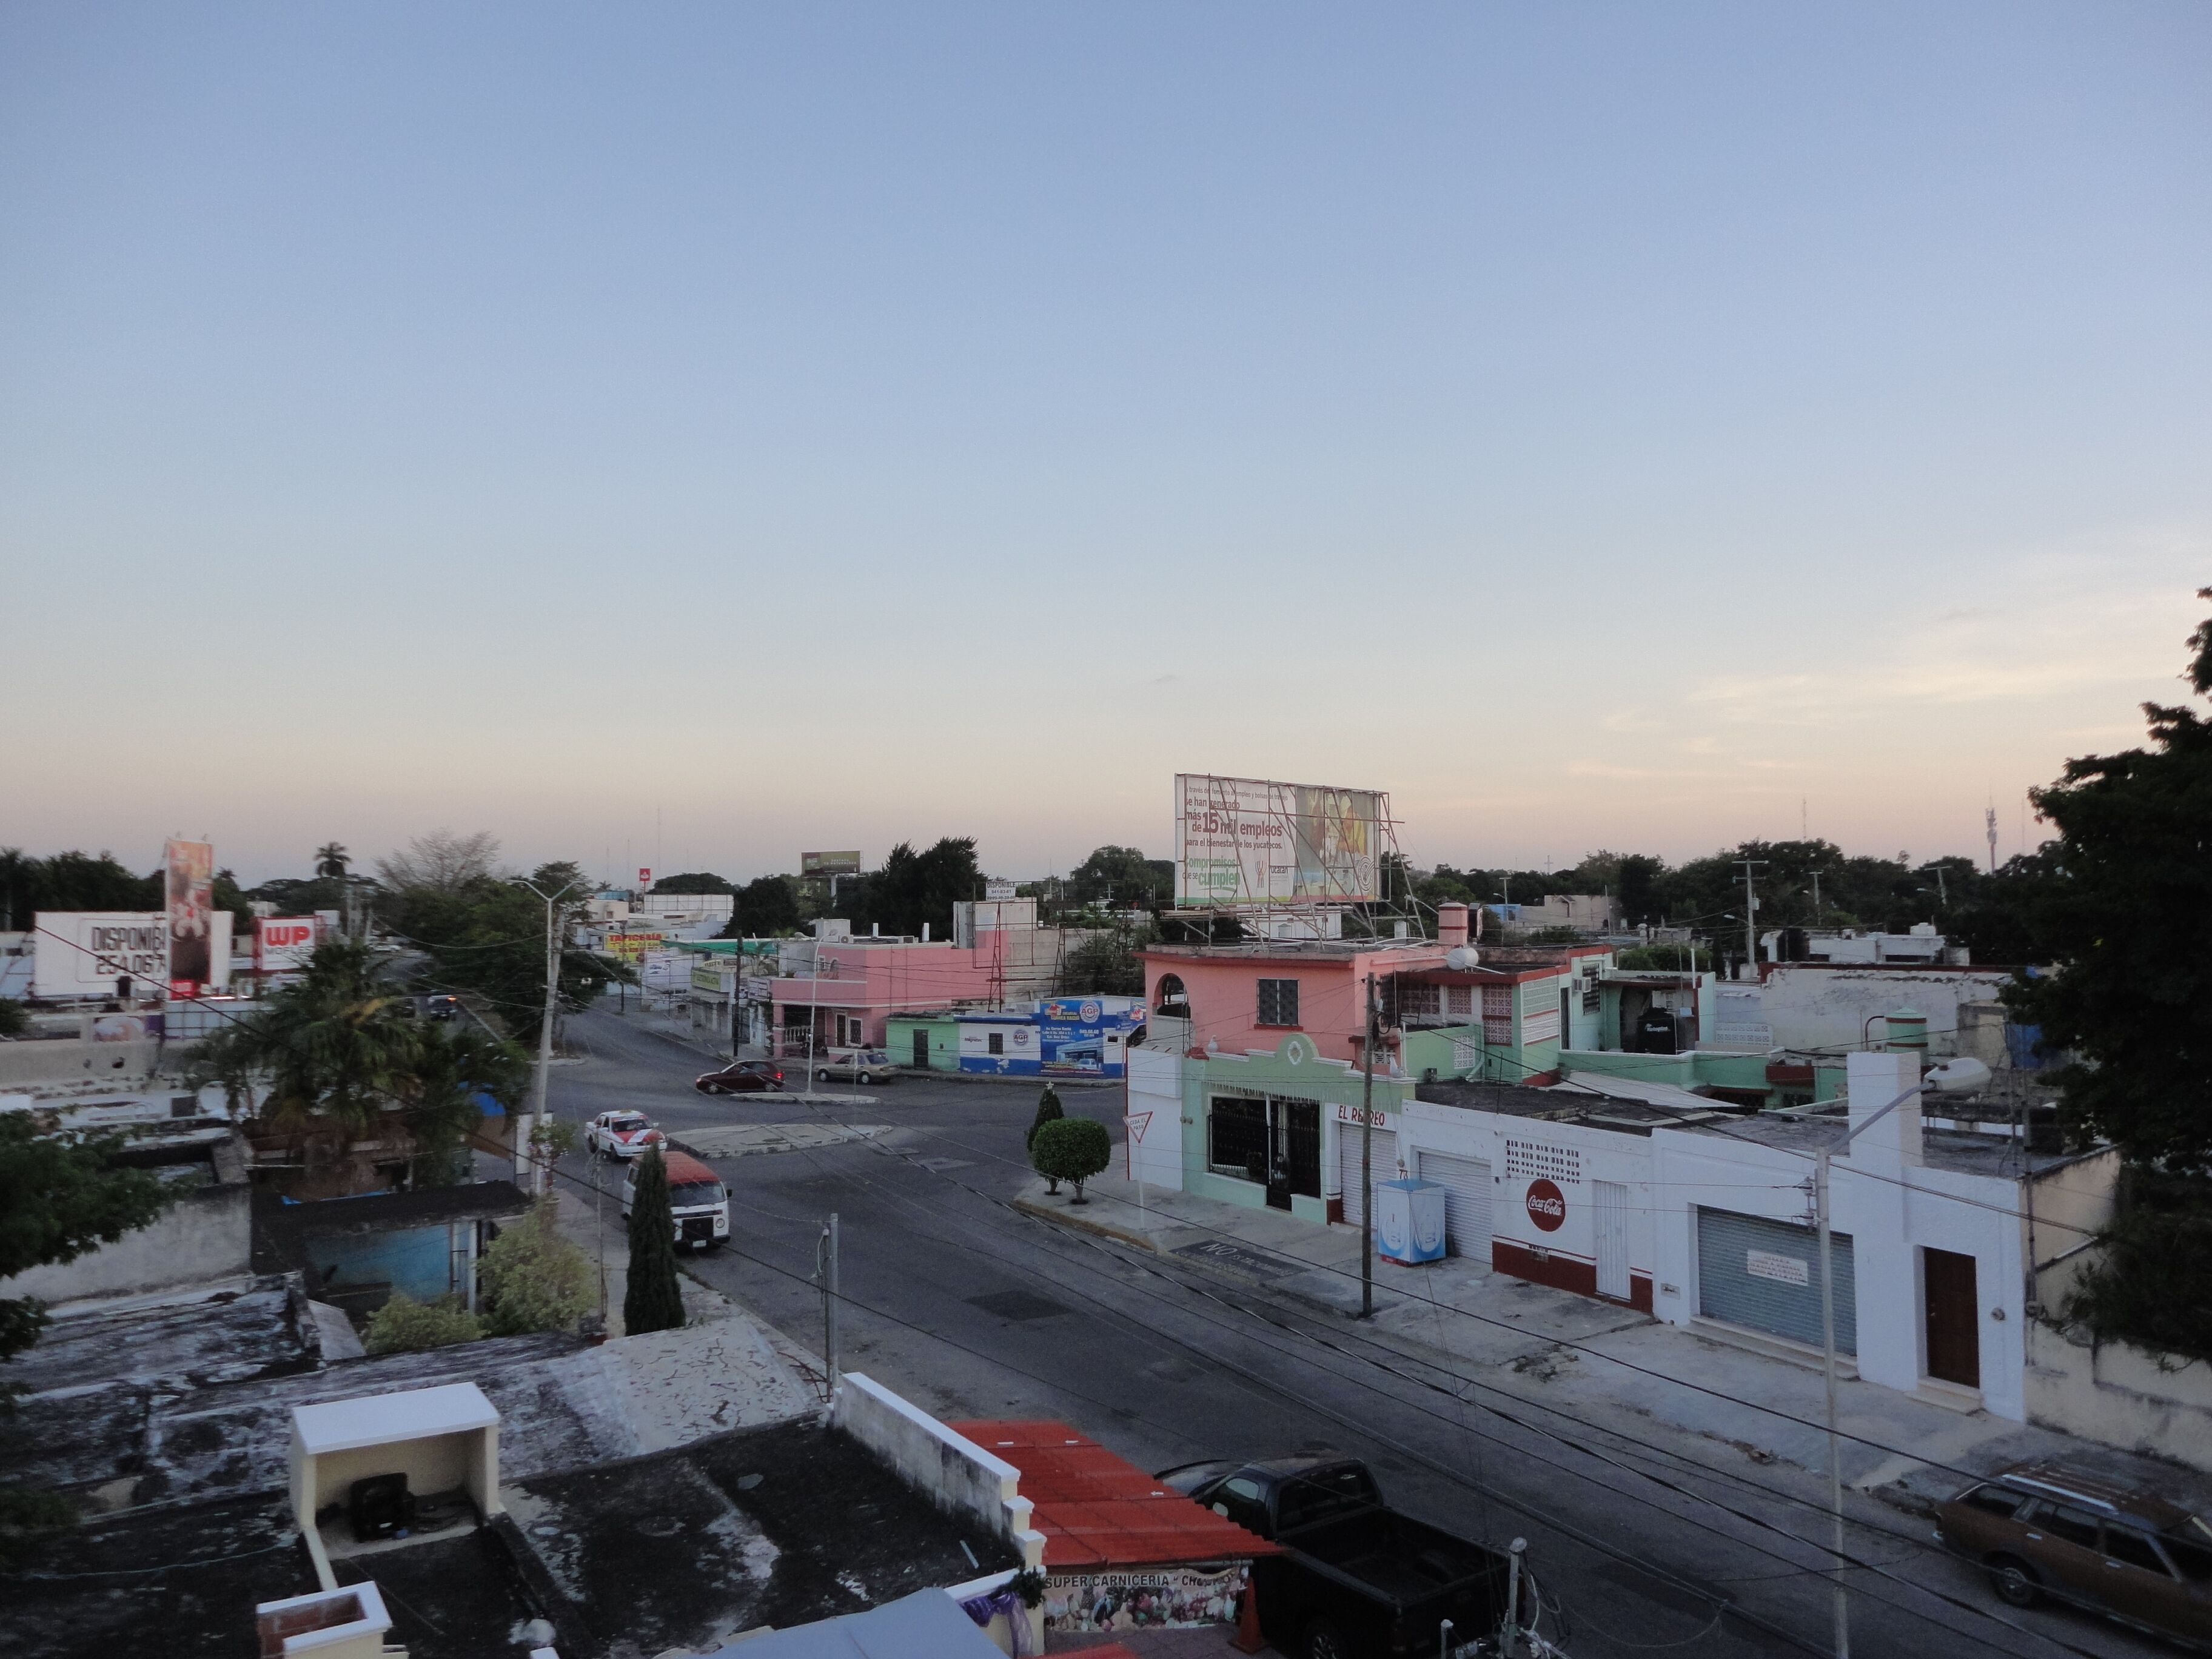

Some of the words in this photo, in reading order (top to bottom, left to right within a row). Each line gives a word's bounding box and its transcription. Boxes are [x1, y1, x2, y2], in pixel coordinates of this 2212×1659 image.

[1212, 788, 1230, 796] fomnto
[1194, 796, 1207, 807] han
[1187, 808, 1201, 821] más
[1192, 821, 1202, 833] de
[1203, 811, 1219, 834] 15
[1221, 819, 1236, 835] mil
[1240, 820, 1282, 840] empleos
[1200, 837, 1205, 846] el
[1244, 840, 1252, 849] los
[1253, 841, 1283, 850] yucatecos.
[1198, 868, 1241, 889] cumplen
[266, 926, 310, 947] WP
[1338, 1105, 1348, 1120] EL
[1351, 1107, 1385, 1127] REREO
[1044, 1576, 1088, 1589] SUPER
[1092, 1575, 1170, 1587] CARNICERIA
